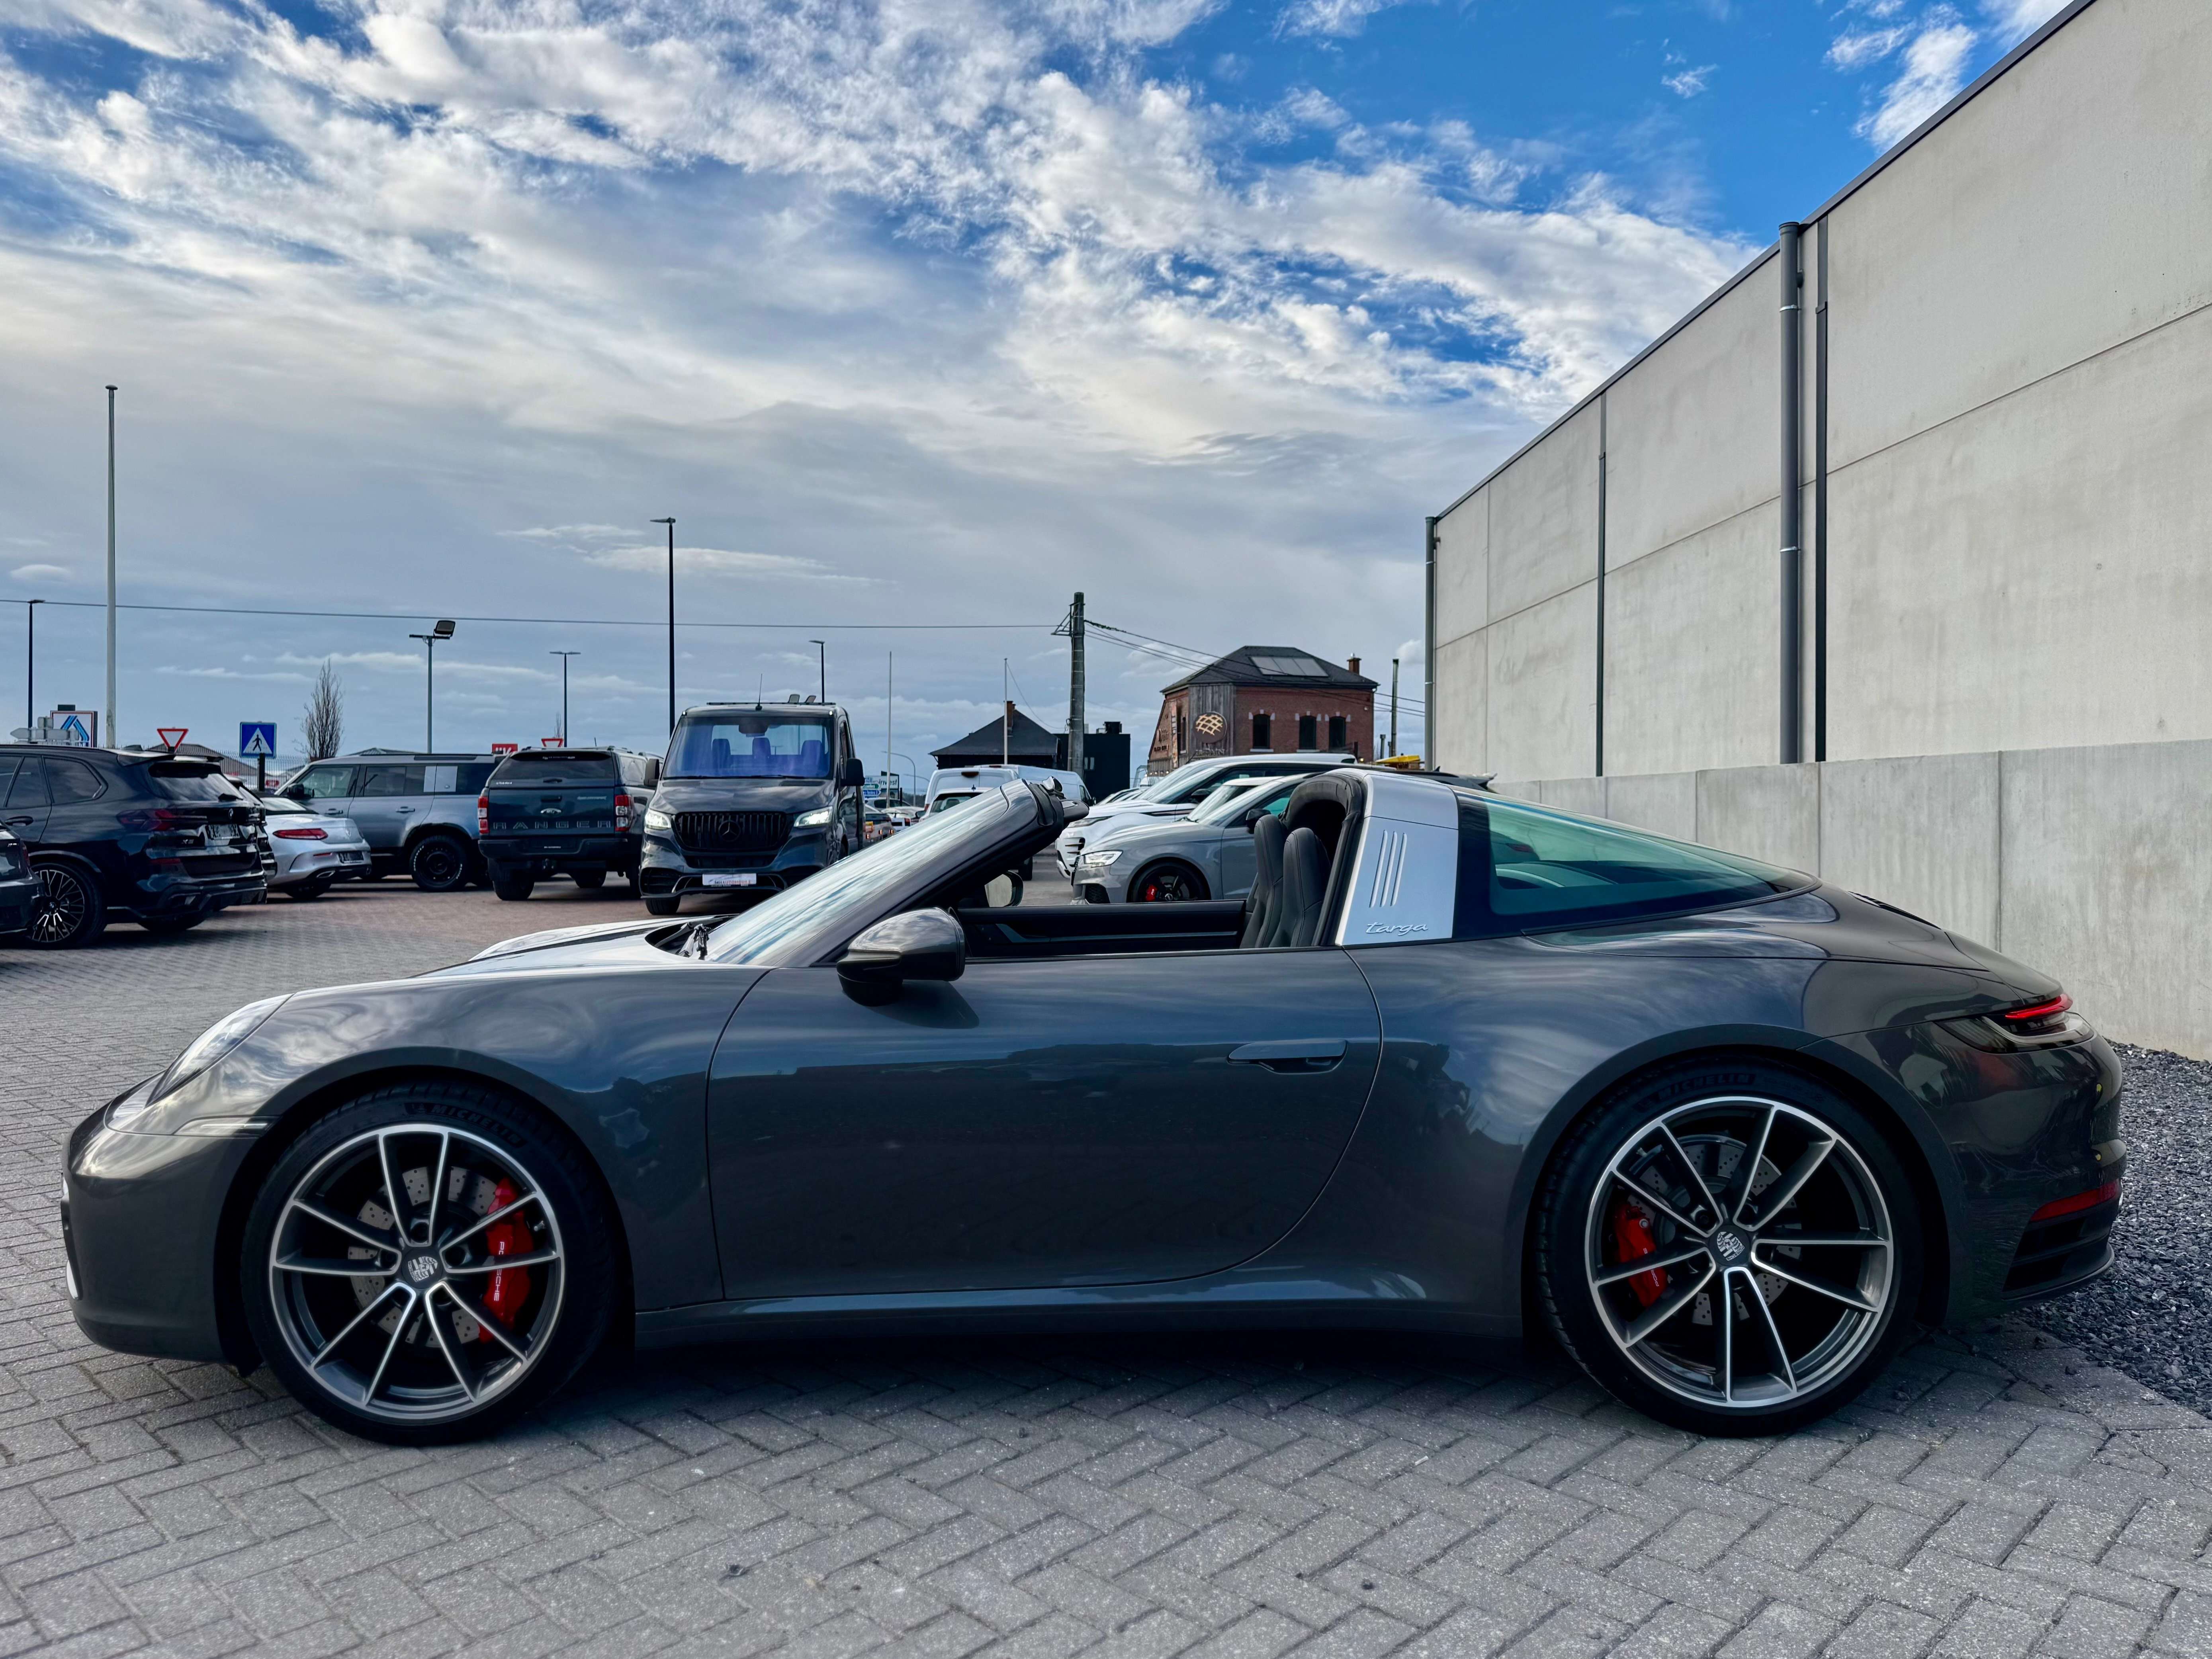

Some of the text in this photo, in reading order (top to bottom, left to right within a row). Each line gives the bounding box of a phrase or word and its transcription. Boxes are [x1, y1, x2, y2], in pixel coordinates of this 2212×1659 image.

[493, 820, 611, 830] RANGER
[1366, 922, 1429, 936] targa
[432, 1104, 520, 1144] MICHELIN
[494, 1241, 505, 1301] POSCHE
